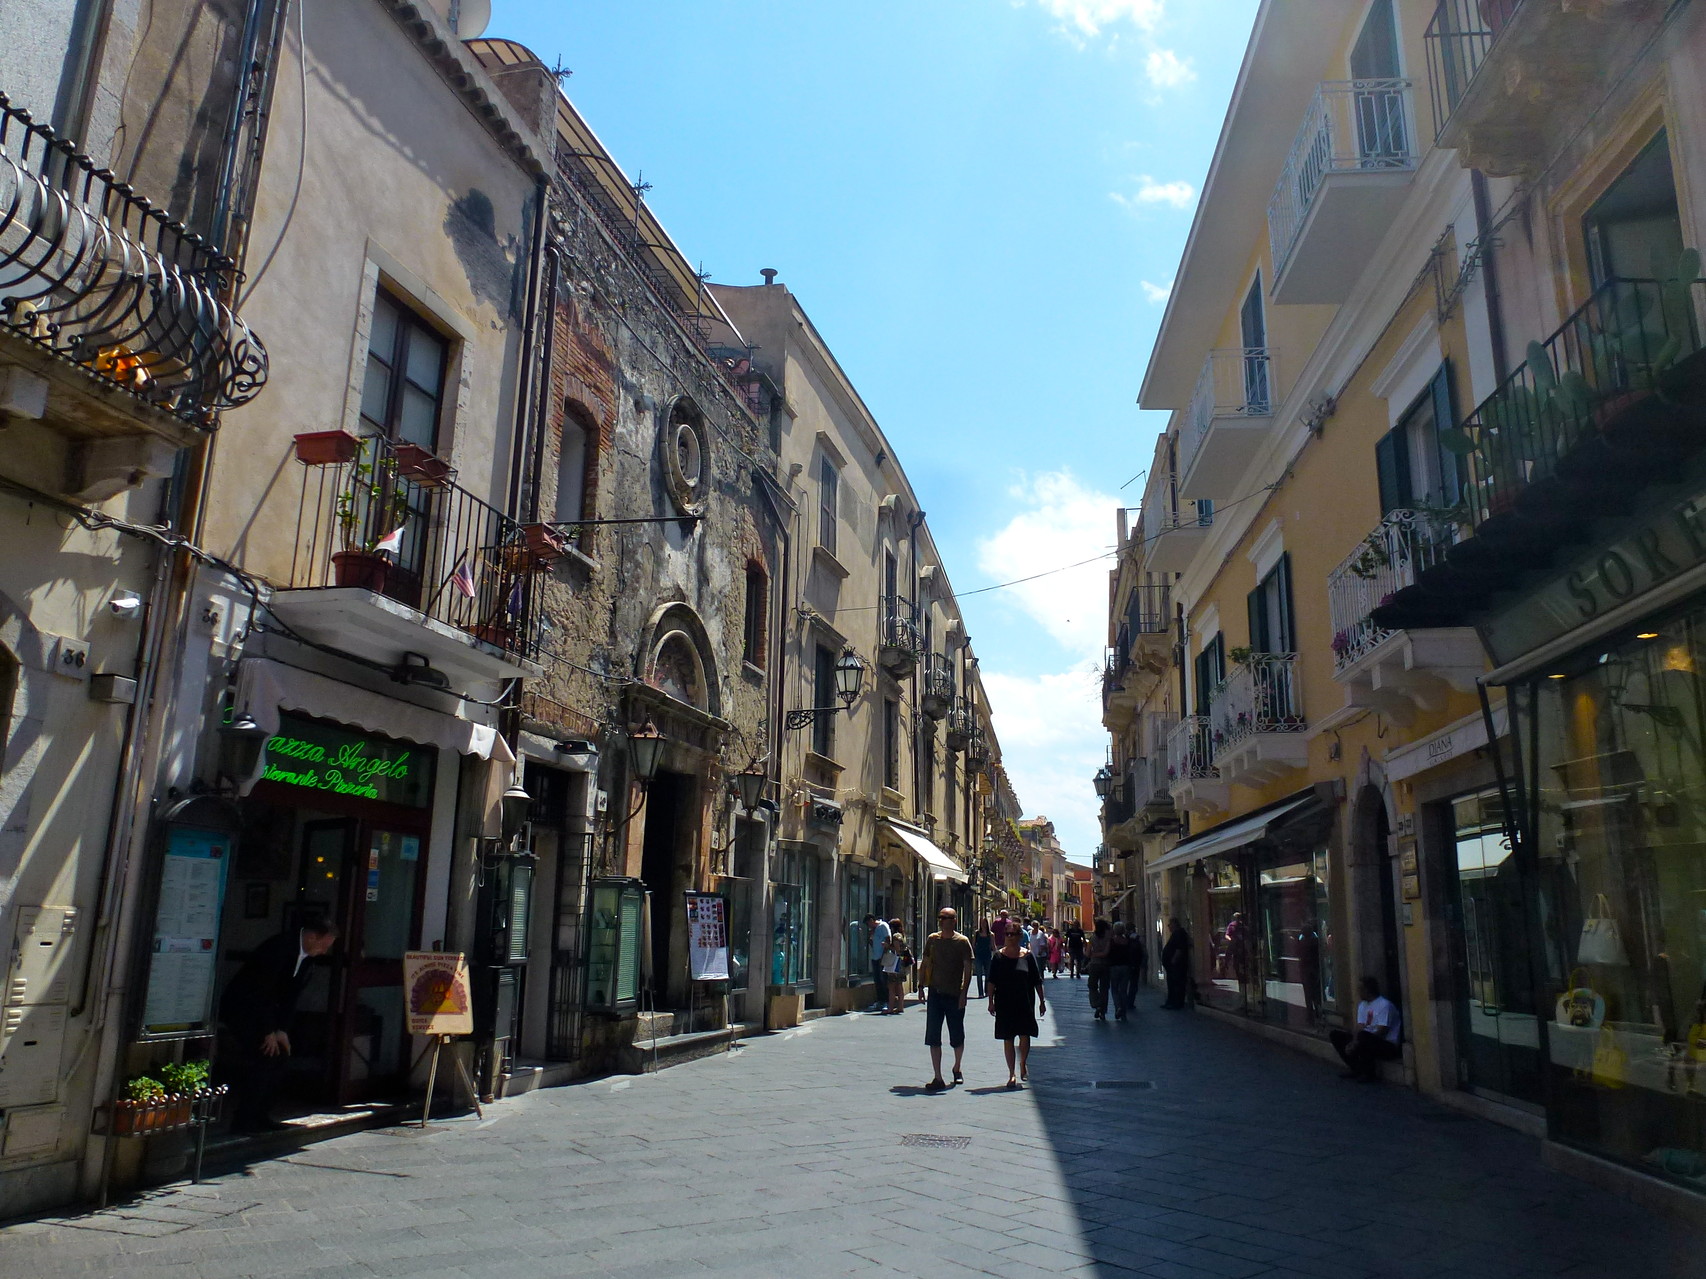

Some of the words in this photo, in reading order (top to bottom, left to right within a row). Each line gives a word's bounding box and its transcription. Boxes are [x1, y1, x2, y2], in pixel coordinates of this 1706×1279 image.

[266, 735, 326, 764] azza
[327, 739, 410, 783] Angelo
[1428, 735, 1453, 756] DIANA
[260, 762, 319, 788] storante
[317, 768, 379, 800] Pizzeria
